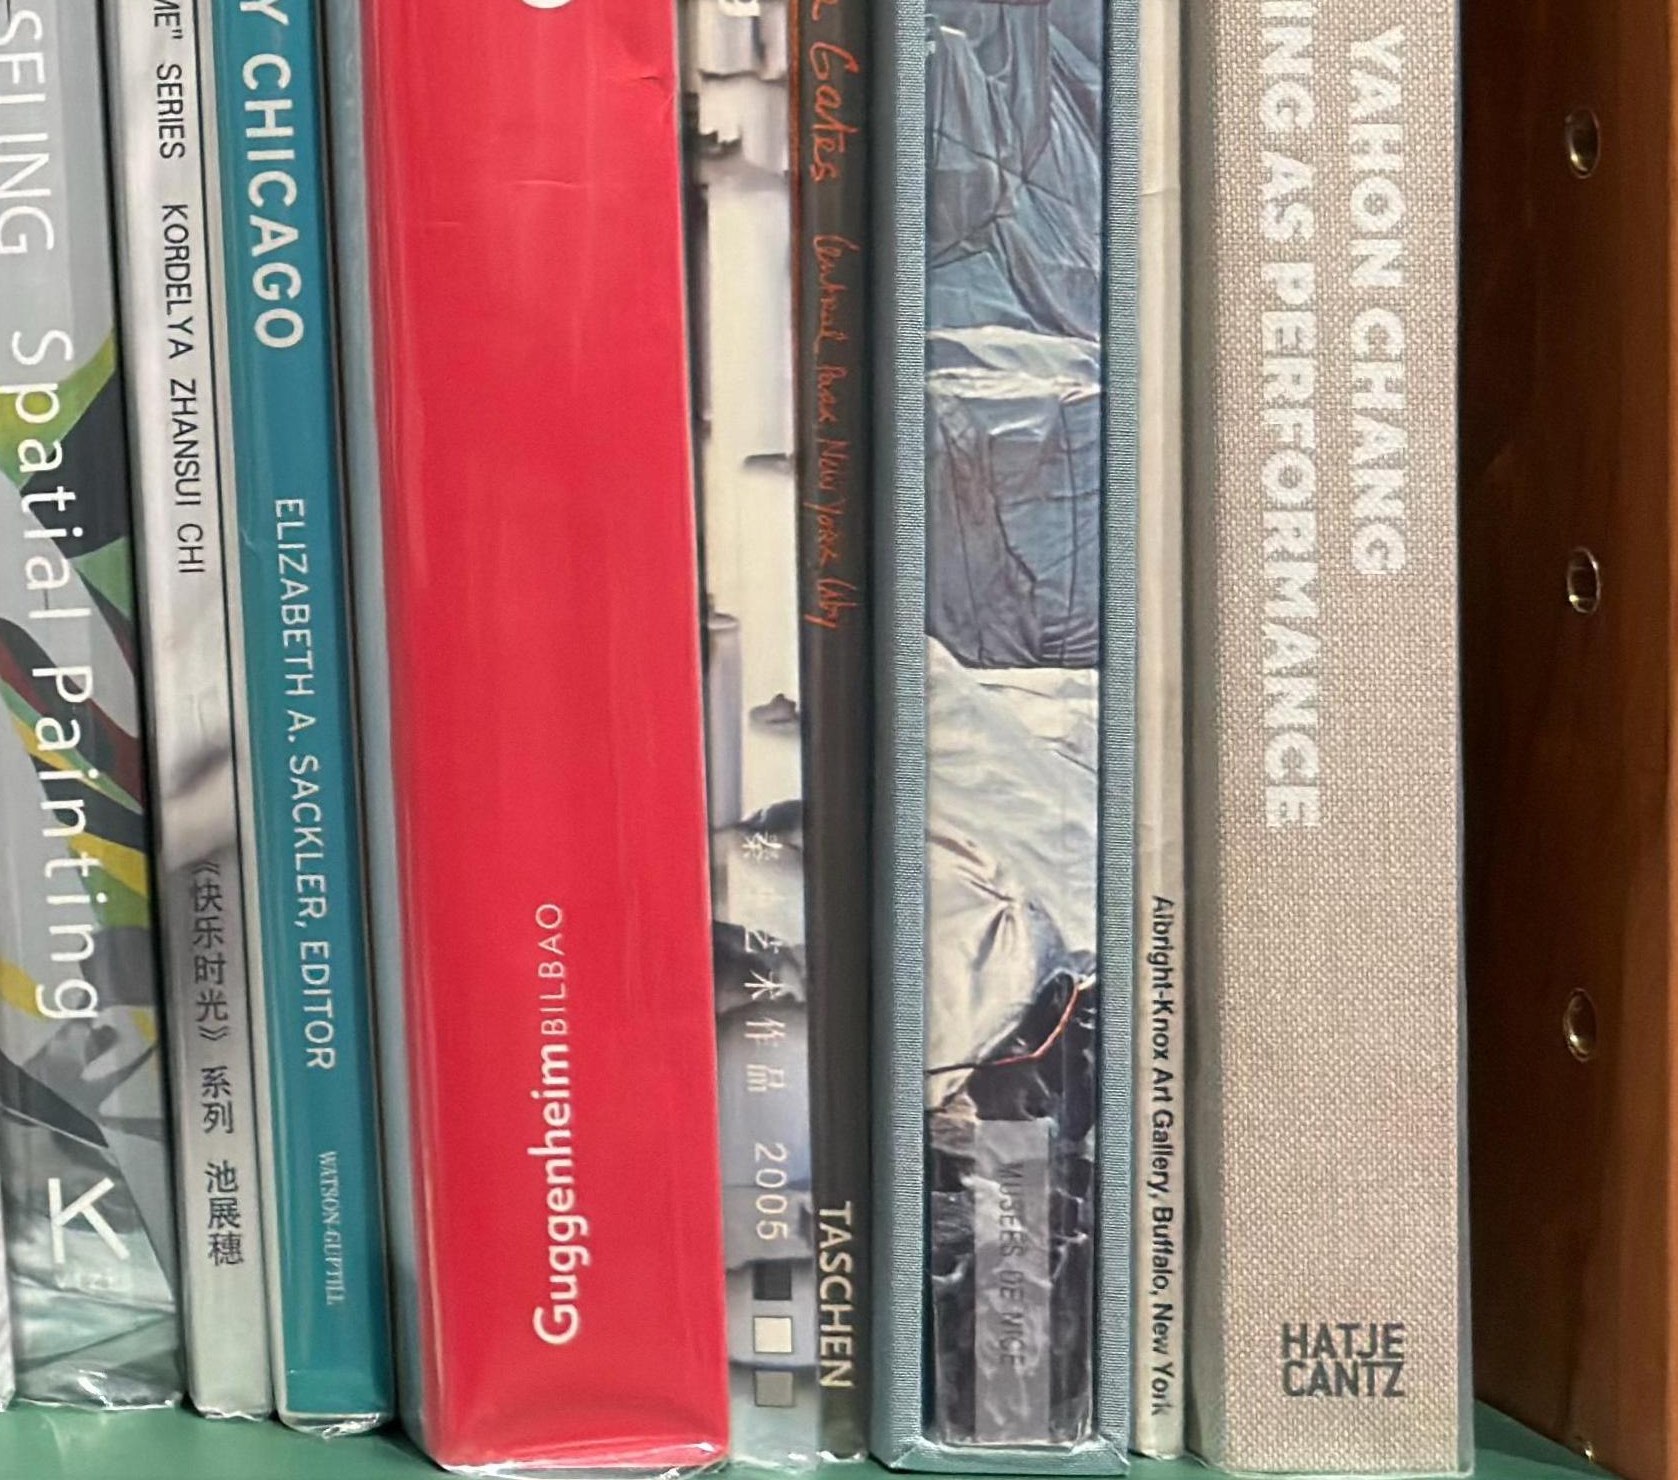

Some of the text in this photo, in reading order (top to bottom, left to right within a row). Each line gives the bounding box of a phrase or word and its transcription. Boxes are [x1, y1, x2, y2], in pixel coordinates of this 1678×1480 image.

[808, 40, 861, 185] Gates
[242, 52, 306, 350] CHICAGO
[1259, 149, 1315, 243] AS
[154, 64, 205, 575] SERIES KORDELYA ZHANSUI CHI
[1348, 23, 1408, 576] YAHON CHANG
[274, 497, 316, 696] ELIZABETH
[1260, 261, 1324, 828] PERFORMANCE
[31, 665, 108, 1021] Painting
[289, 753, 329, 928] SACKLER,
[299, 939, 337, 1071] EDITOR
[1146, 895, 1176, 1061] Albright-Knox
[199, 1064, 235, 1135] 系列
[526, 903, 591, 1345] Guggenheim BILBAO
[205, 1160, 245, 1268] 池展穗
[752, 1139, 789, 1242] 2005
[817, 1200, 854, 1391] TASCHEN
[1151, 1301, 1174, 1364] New
[1281, 1322, 1405, 1359] HATJE
[1282, 1360, 1405, 1397] CANTZ
